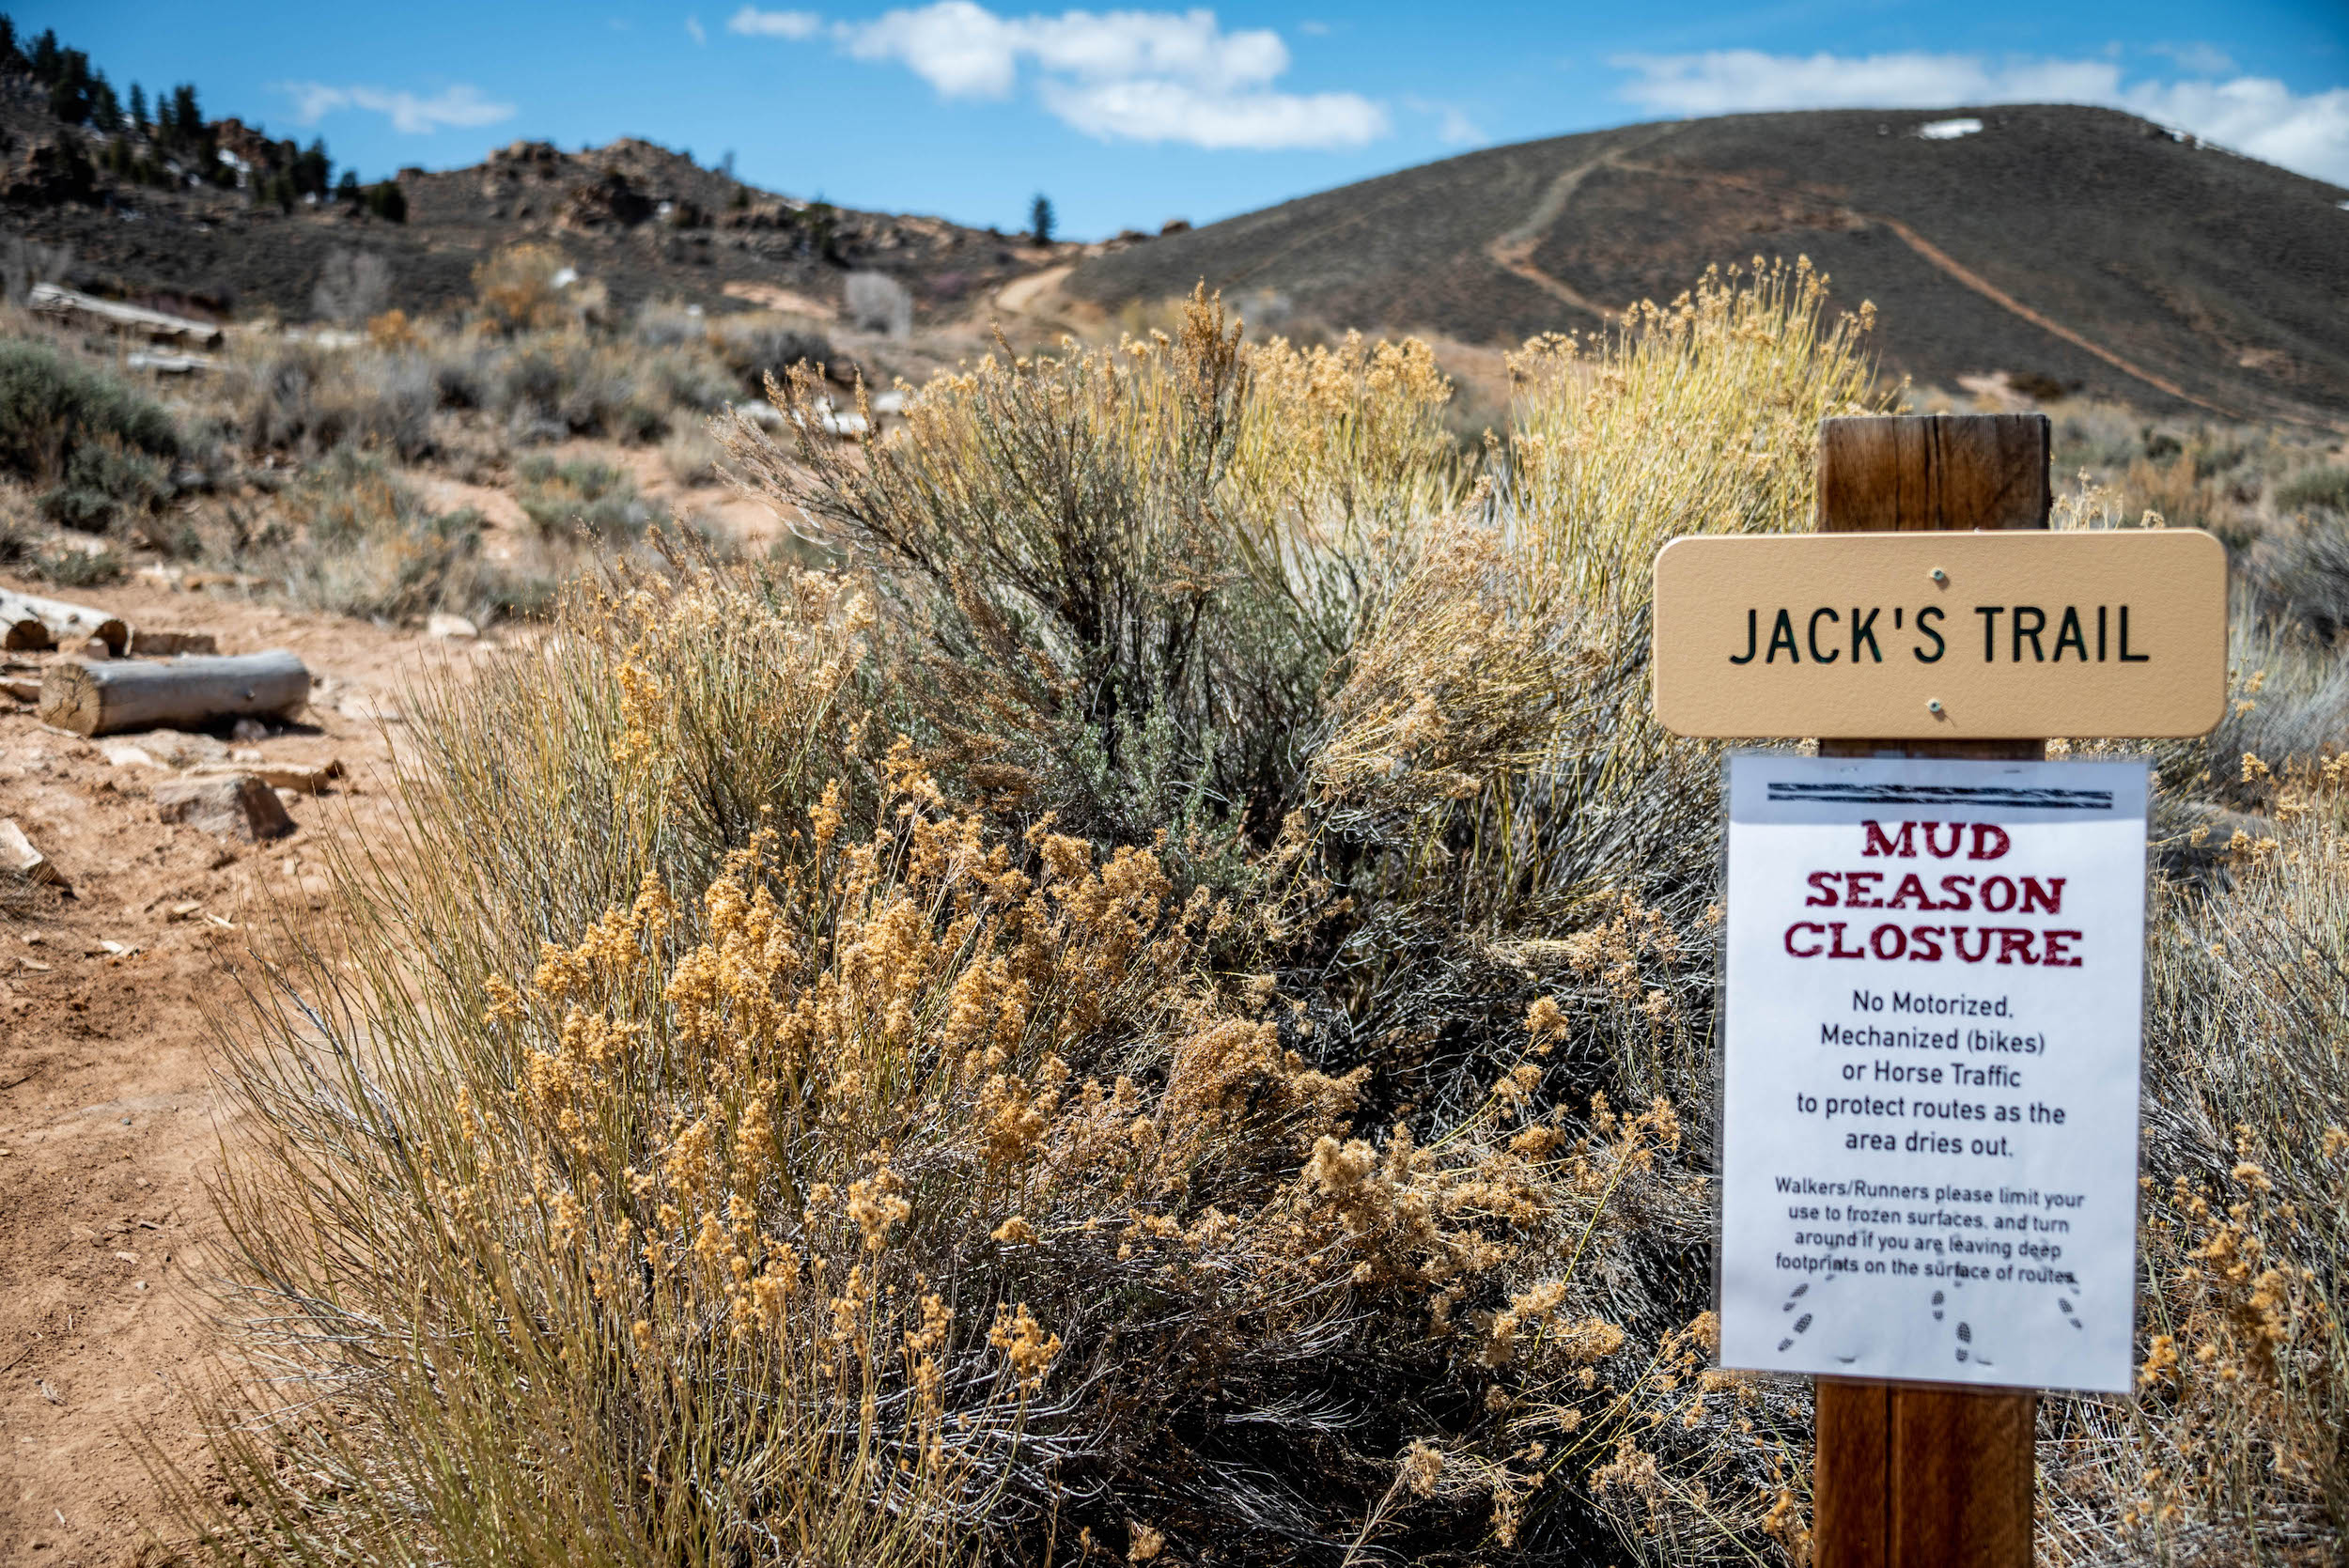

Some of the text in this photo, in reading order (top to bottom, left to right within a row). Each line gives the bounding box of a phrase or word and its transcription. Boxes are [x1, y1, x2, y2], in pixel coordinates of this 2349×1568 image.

[1729, 605, 2150, 664] JACK'S TRAIL
[1861, 820, 2012, 860] MUD
[1805, 872, 2066, 914] SEASON
[1784, 922, 2083, 967] CLOSURE
[1853, 990, 1883, 1012] No
[1821, 1024, 2045, 1054] Mechanized (bikes)
[1843, 1061, 2021, 1088] or Horse Traffic
[1797, 1094, 2065, 1124] to protect routes as the
[1845, 1131, 2014, 1157] area dries out.
[1776, 1176, 2085, 1209] Walkers/Runners please limit your
[1789, 1205, 1818, 1221] use
[1825, 1205, 1841, 1221] to
[1847, 1205, 1901, 1224] frozen
[1994, 1215, 2027, 1232] and
[2032, 1217, 2069, 1233] turn
[1795, 1230, 2061, 1260] around if you are leaving deep
[1776, 1254, 1859, 1274] footprints
[1864, 1260, 1885, 1273] on
[1891, 1259, 1919, 1276] the
[1924, 1261, 1990, 1280] surface
[1996, 1263, 2013, 1281] of
